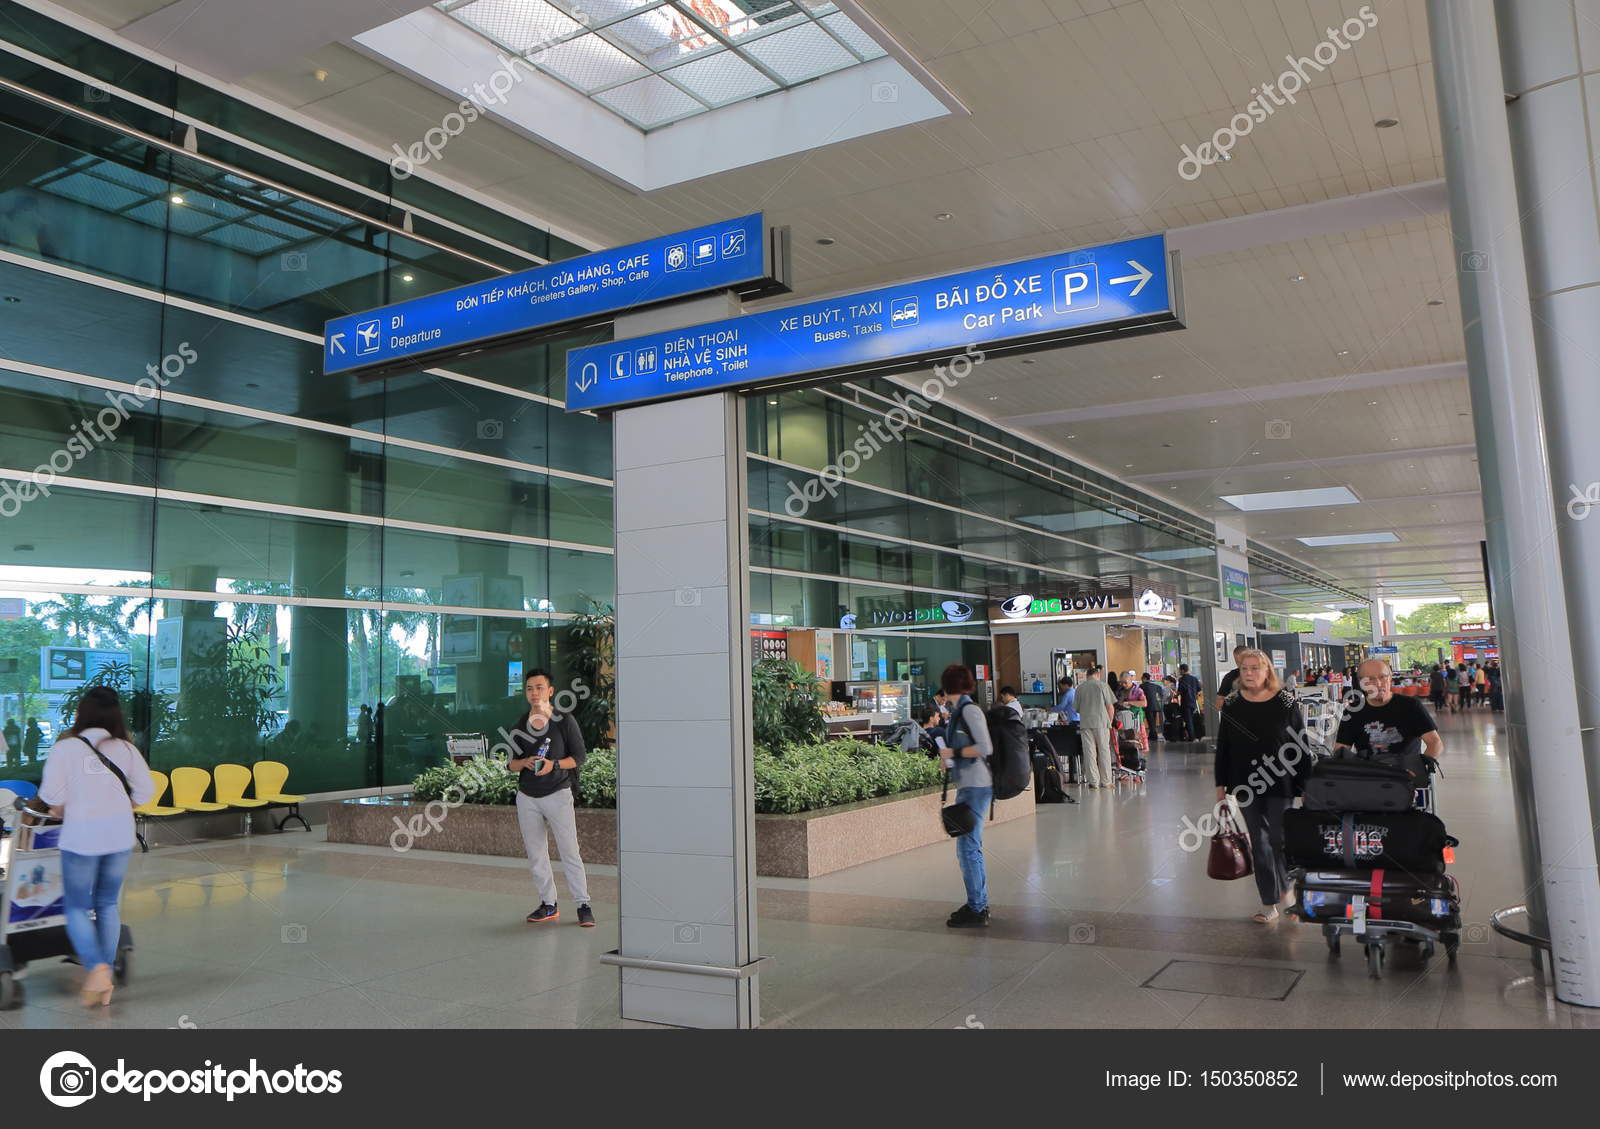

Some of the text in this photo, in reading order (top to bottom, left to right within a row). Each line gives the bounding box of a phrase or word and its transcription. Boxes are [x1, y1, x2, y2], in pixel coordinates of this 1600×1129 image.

[456, 254, 649, 312] ĐÓN TIẾP KHÁCH, CỬA HÀNG, CAFE
[531, 270, 649, 304] Greeters Gallery, Shop, Cafe
[936, 274, 1043, 310] BÃI ĐỖ XE
[1064, 271, 1089, 306] P
[391, 314, 404, 329] ĐI
[780, 301, 882, 332] XE BUÝT, TAXI
[963, 303, 1043, 330] Car Park
[391, 328, 441, 349] Departure
[665, 329, 738, 354] ĐIỆN THOẠI
[814, 322, 883, 343] Buses, Taxis
[664, 344, 747, 371] NHÀ VỆ SINH
[664, 367, 713, 382] Telephone
[721, 359, 748, 372] Toilet
[1031, 594, 1120, 614] BIGBOWL
